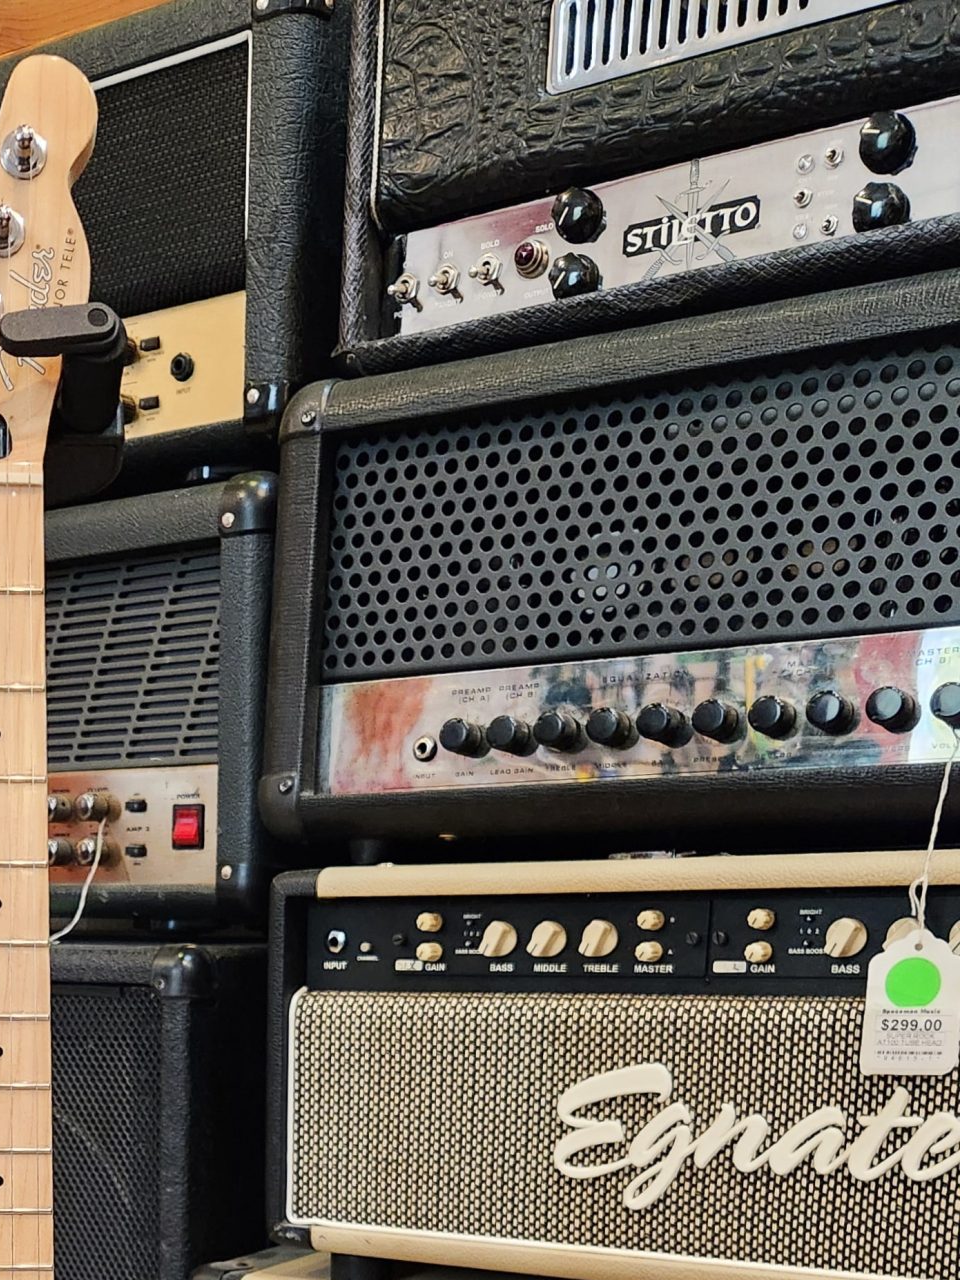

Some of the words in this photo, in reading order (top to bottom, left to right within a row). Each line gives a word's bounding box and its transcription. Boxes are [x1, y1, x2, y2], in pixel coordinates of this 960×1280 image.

[451, 687, 492, 696] PREAMP
[499, 683, 540, 692] PREAMP
[323, 961, 348, 971] INPUT
[424, 963, 446, 972] GAIN
[490, 963, 514, 973] BASS
[533, 963, 568, 973] MIDDLE
[582, 963, 619, 973] TREBLE
[633, 964, 674, 974] MASTER
[749, 964, 776, 974] GAIN
[830, 964, 861, 974] BASS
[881, 1018, 942, 1031] $299.00
[553, 1062, 960, 1210] Egnate
